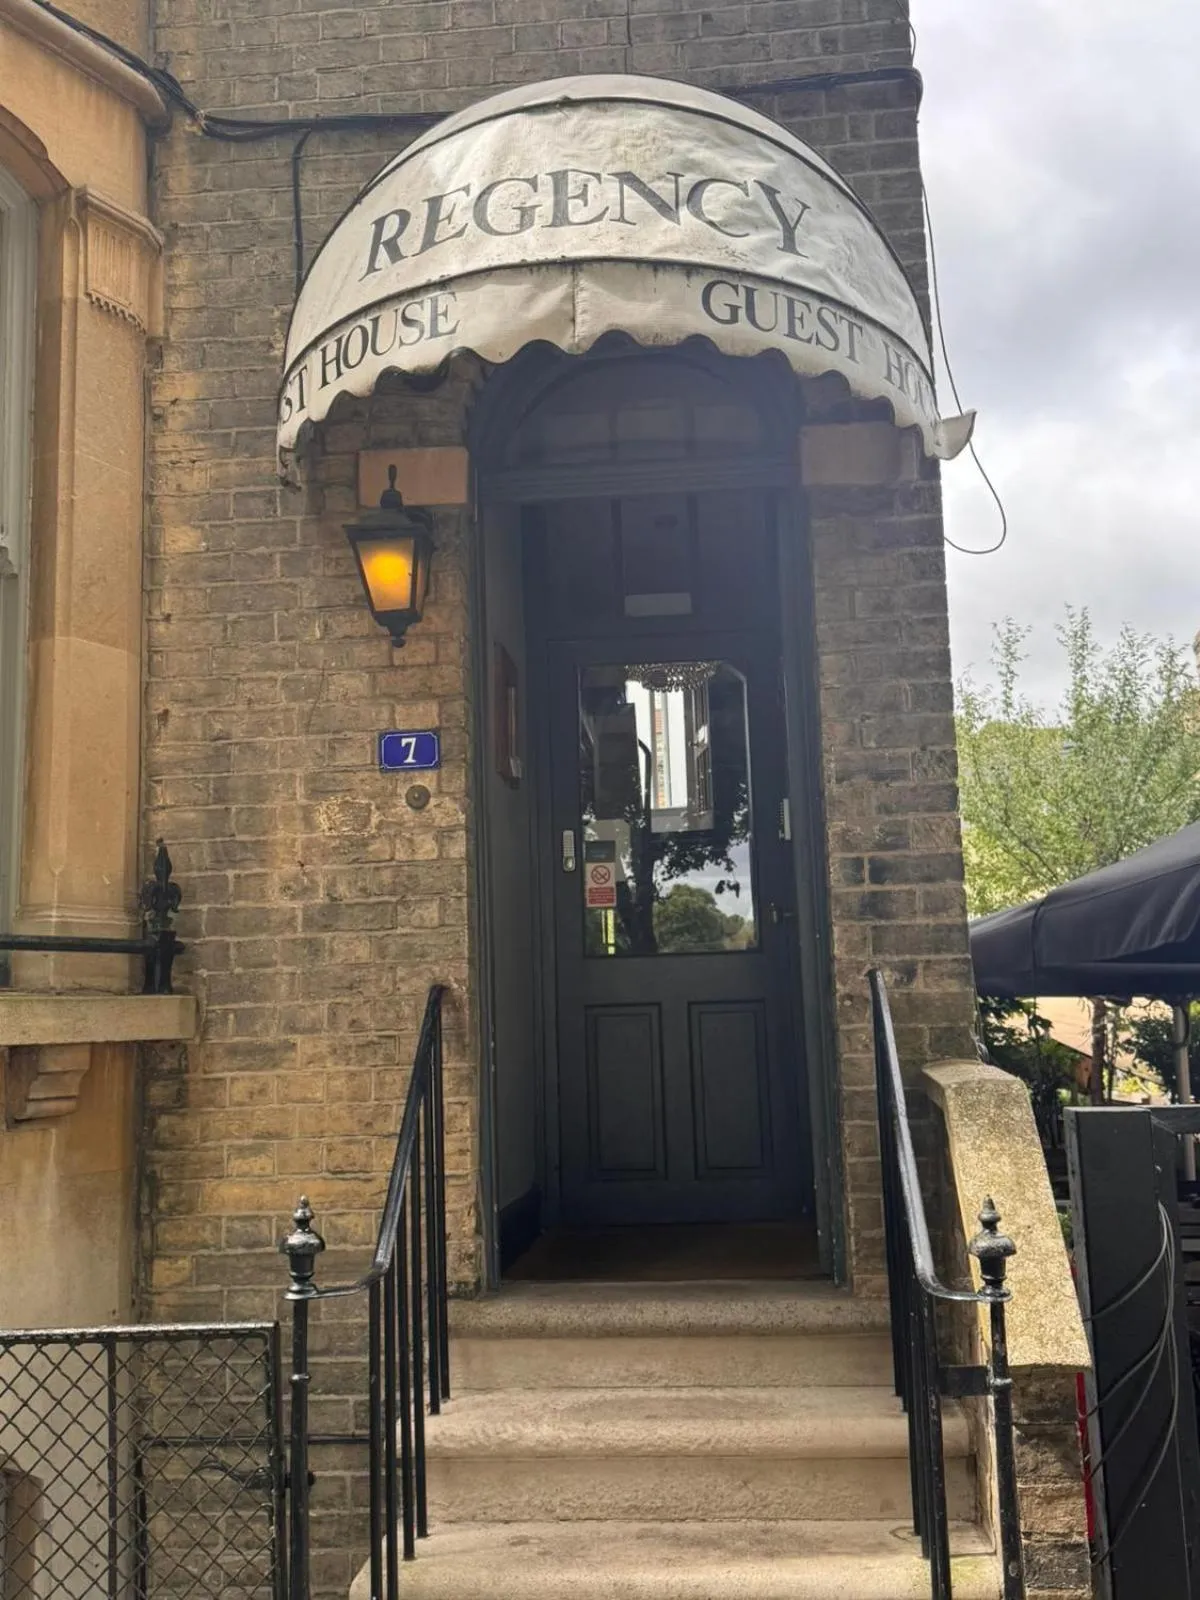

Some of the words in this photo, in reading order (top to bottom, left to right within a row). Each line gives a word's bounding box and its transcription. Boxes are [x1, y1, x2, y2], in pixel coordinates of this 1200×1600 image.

[359, 168, 811, 281] REGENCY
[318, 291, 461, 391] HOUSE
[701, 279, 864, 364] GUEST
[401, 737, 417, 763] 7
